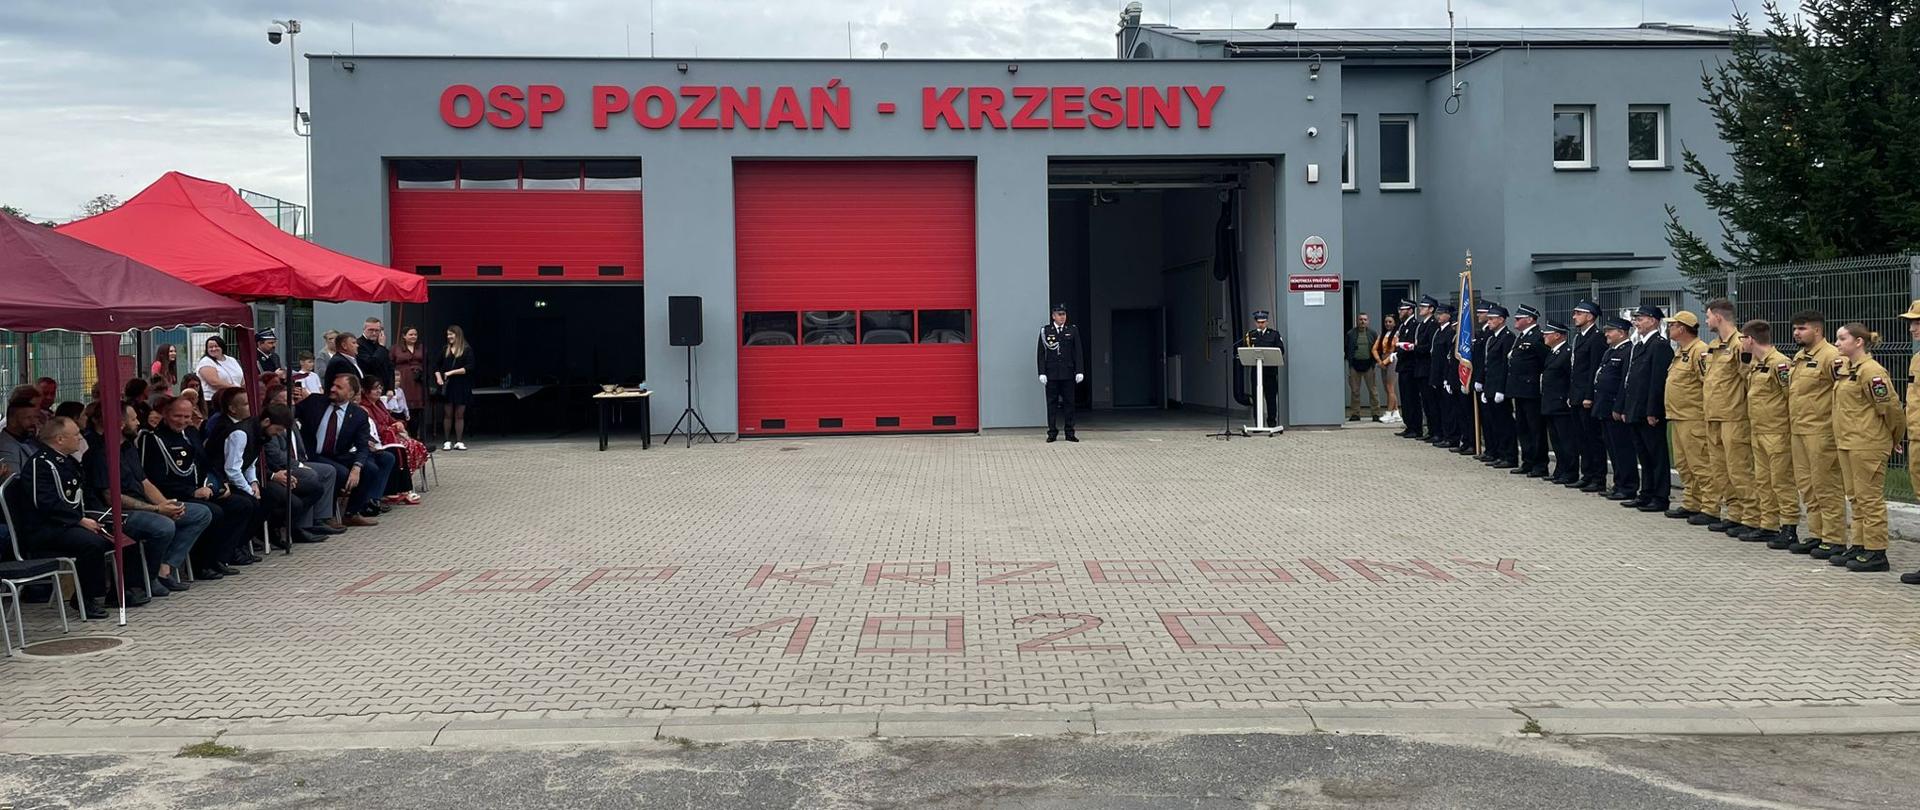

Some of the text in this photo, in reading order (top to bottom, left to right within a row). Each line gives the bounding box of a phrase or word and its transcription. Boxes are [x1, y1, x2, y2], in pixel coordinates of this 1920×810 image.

[439, 78, 1226, 130] OSP POZNAŃ - KRZESINY
[336, 558, 1530, 596] OSP KRZESINY
[729, 609, 1289, 656] 1920
